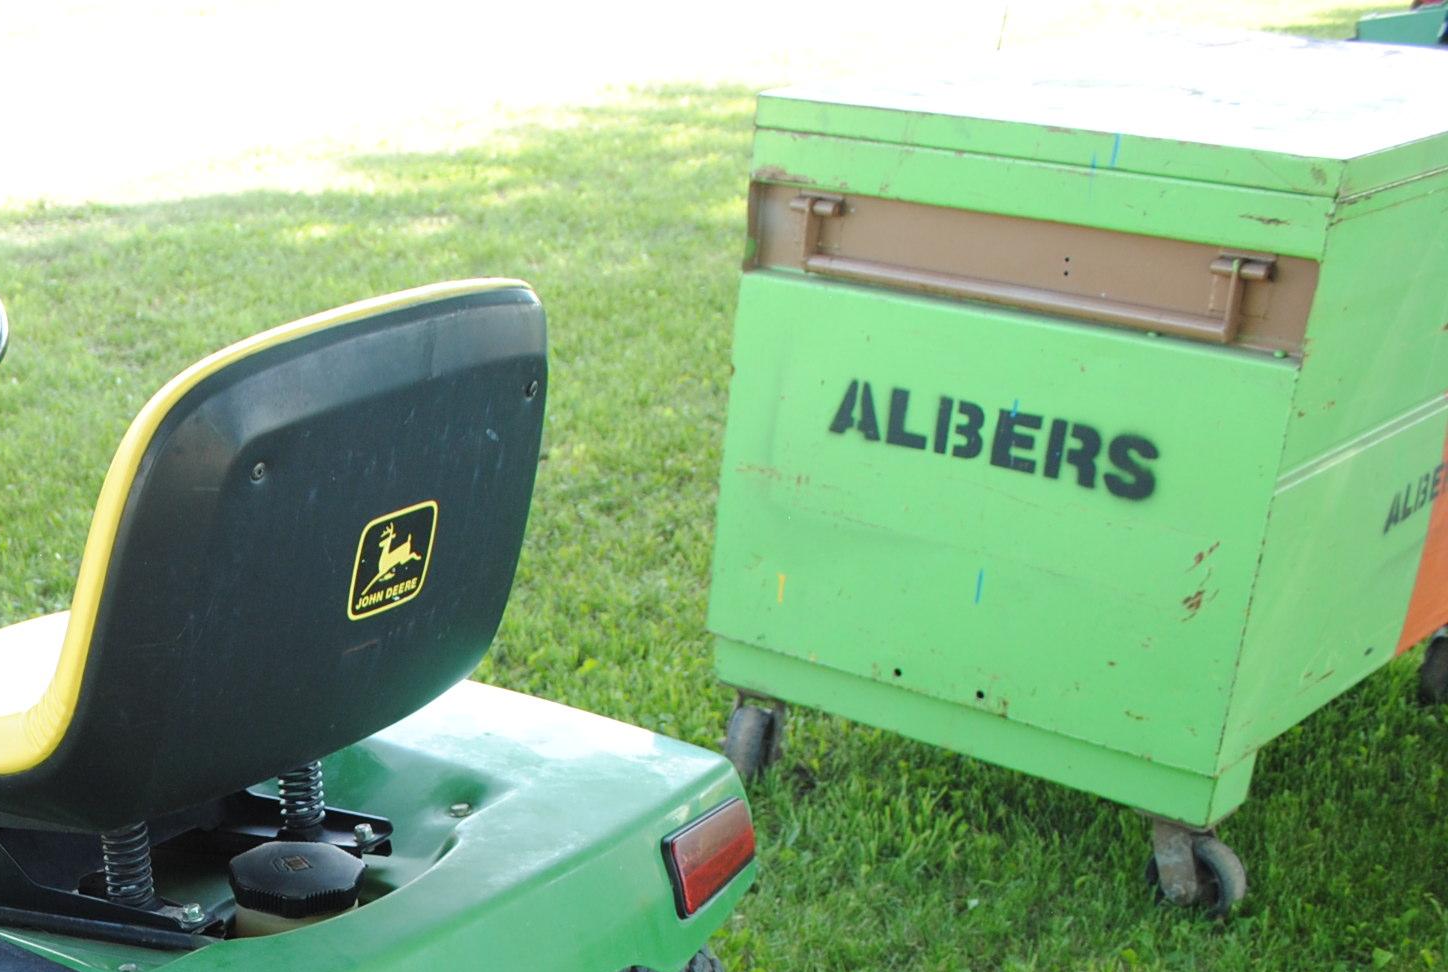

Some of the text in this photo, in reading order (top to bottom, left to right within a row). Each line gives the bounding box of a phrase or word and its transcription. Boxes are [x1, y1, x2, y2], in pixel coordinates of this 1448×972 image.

[828, 378, 1159, 501] ALBERS
[1383, 461, 1448, 536] ALBE
[355, 576, 418, 610] JOHN DEERE
